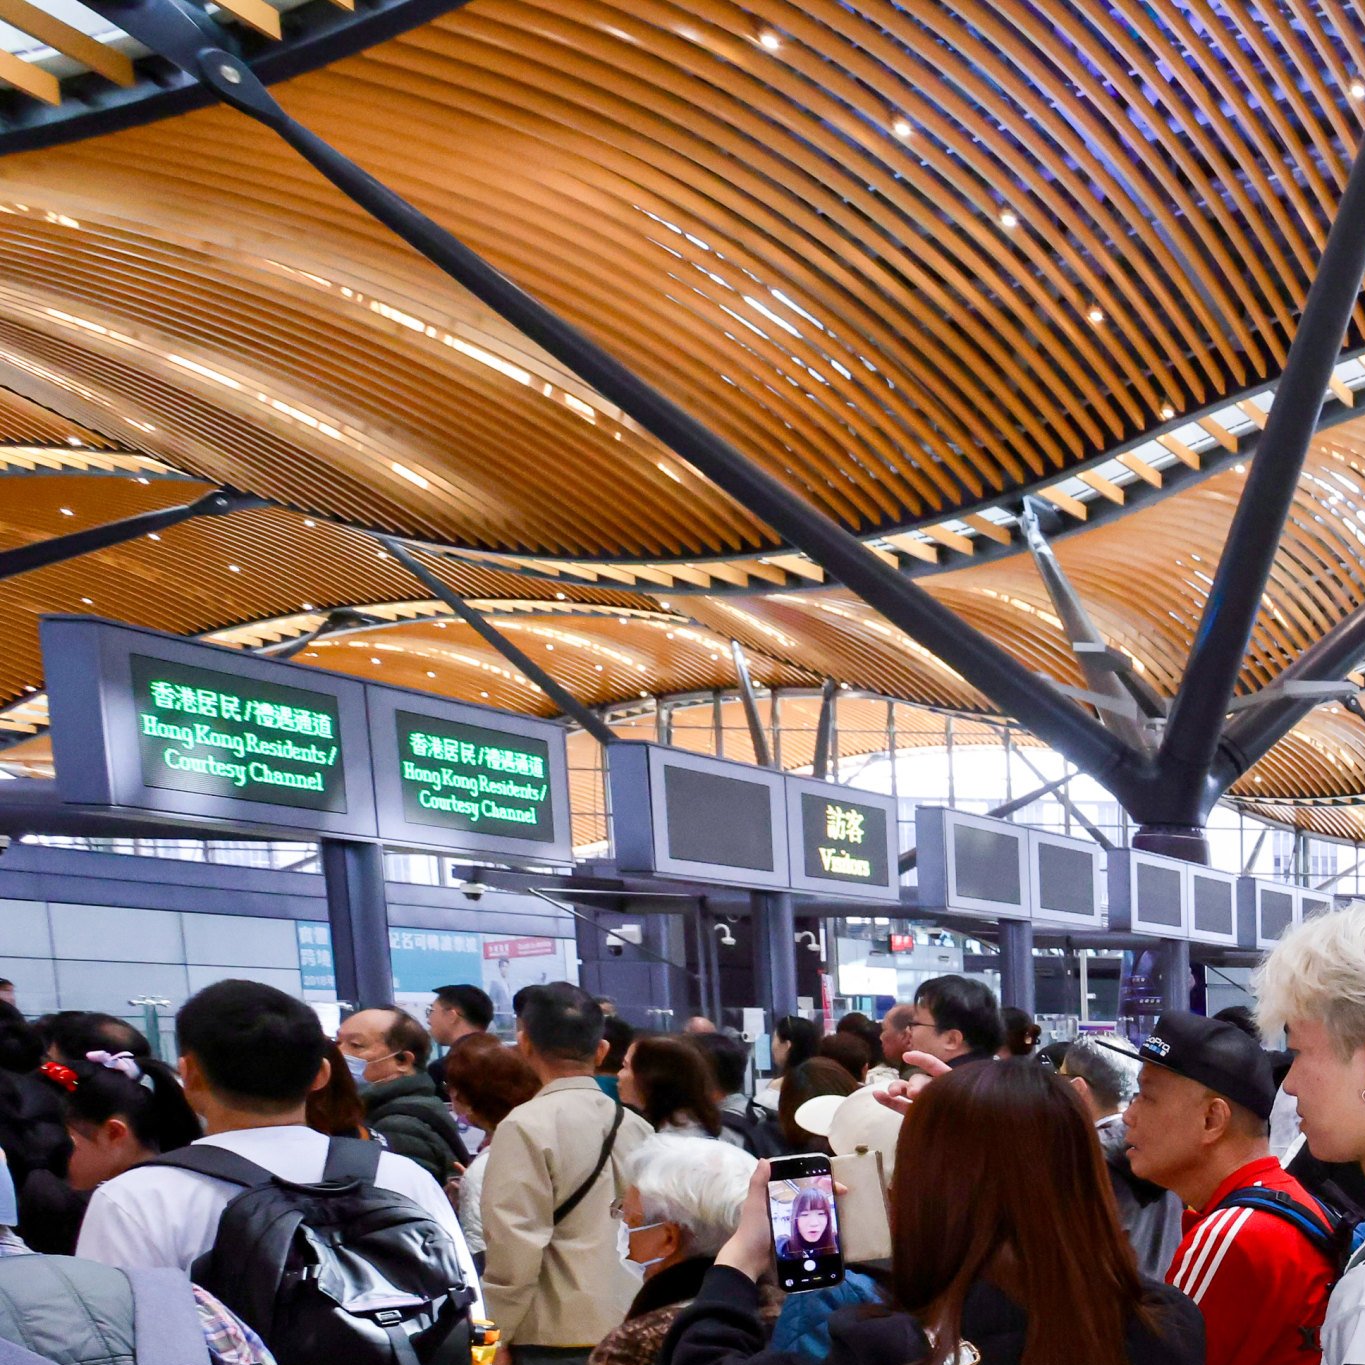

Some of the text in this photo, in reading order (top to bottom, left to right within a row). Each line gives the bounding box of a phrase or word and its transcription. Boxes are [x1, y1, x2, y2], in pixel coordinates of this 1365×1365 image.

[140, 713, 195, 750] Hong
[193, 723, 245, 758] Kong
[164, 747, 325, 792] Courtesy Channel
[402, 760, 441, 791] Hong
[440, 768, 479, 797] Kong
[418, 789, 538, 825] Courtesy Channel
[825, 803, 866, 844] 訪客
[818, 846, 871, 877] Visitors
